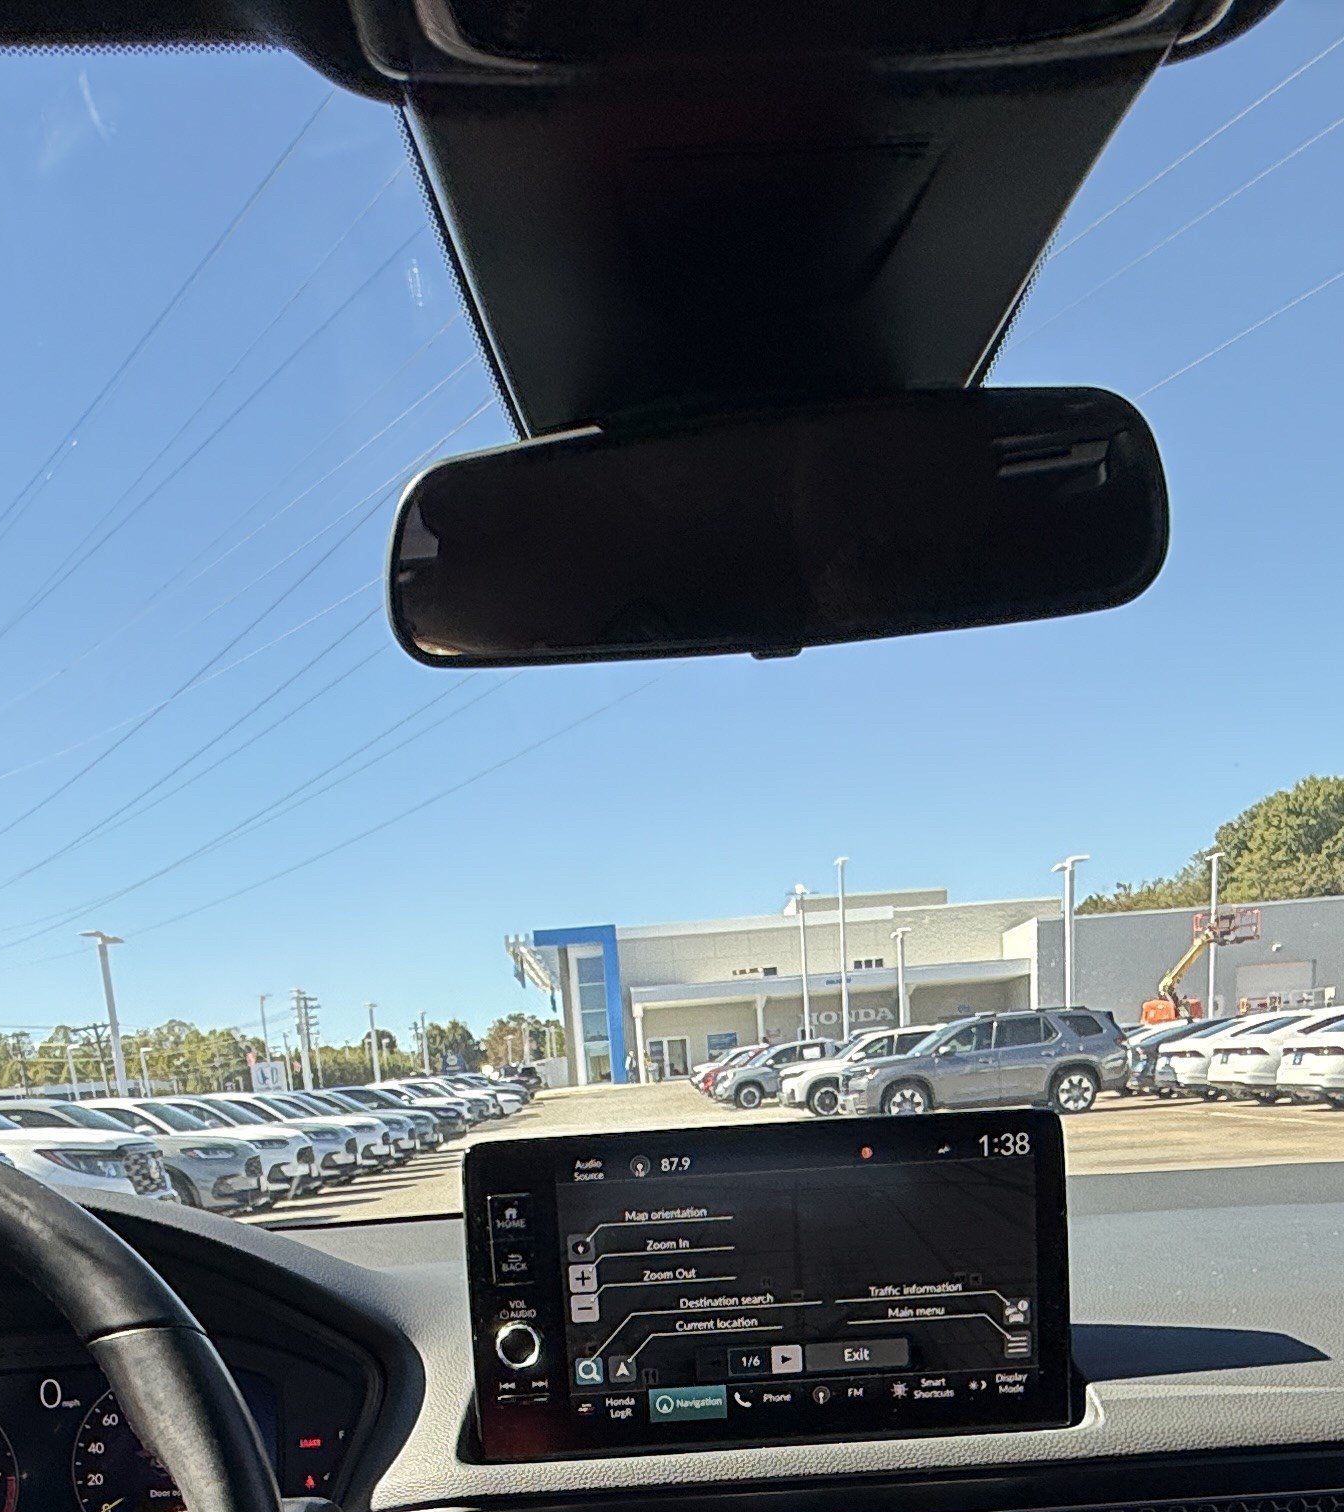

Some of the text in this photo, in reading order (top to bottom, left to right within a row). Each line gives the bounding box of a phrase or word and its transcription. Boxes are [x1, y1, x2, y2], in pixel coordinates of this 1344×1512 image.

[978, 1132, 1031, 1157] 1:38
[660, 1156, 691, 1172] 87.9
[624, 1206, 708, 1222] Map orientation
[646, 1238, 690, 1251] Zoom In
[642, 1268, 697, 1281] Zoom Out
[868, 1281, 963, 1297] Traffic information
[679, 1293, 774, 1309] Destination search
[887, 1306, 946, 1318] Main menu
[675, 1316, 759, 1332] Current location
[843, 1347, 870, 1362] Exit
[741, 1355, 761, 1368] 1/6
[995, 1372, 1029, 1385] Display
[39, 1378, 62, 1408] 0
[847, 1387, 864, 1398] FM
[998, 1383, 1025, 1394] Mode
[606, 1397, 636, 1407] Honda
[676, 1396, 723, 1410] Navigation
[763, 1392, 791, 1403] Phone
[102, 1413, 119, 1426] 60
[609, 1408, 633, 1419] LogR
[87, 1442, 105, 1454] 40
[87, 1473, 104, 1486] 20
[149, 1489, 171, 1498] Door
